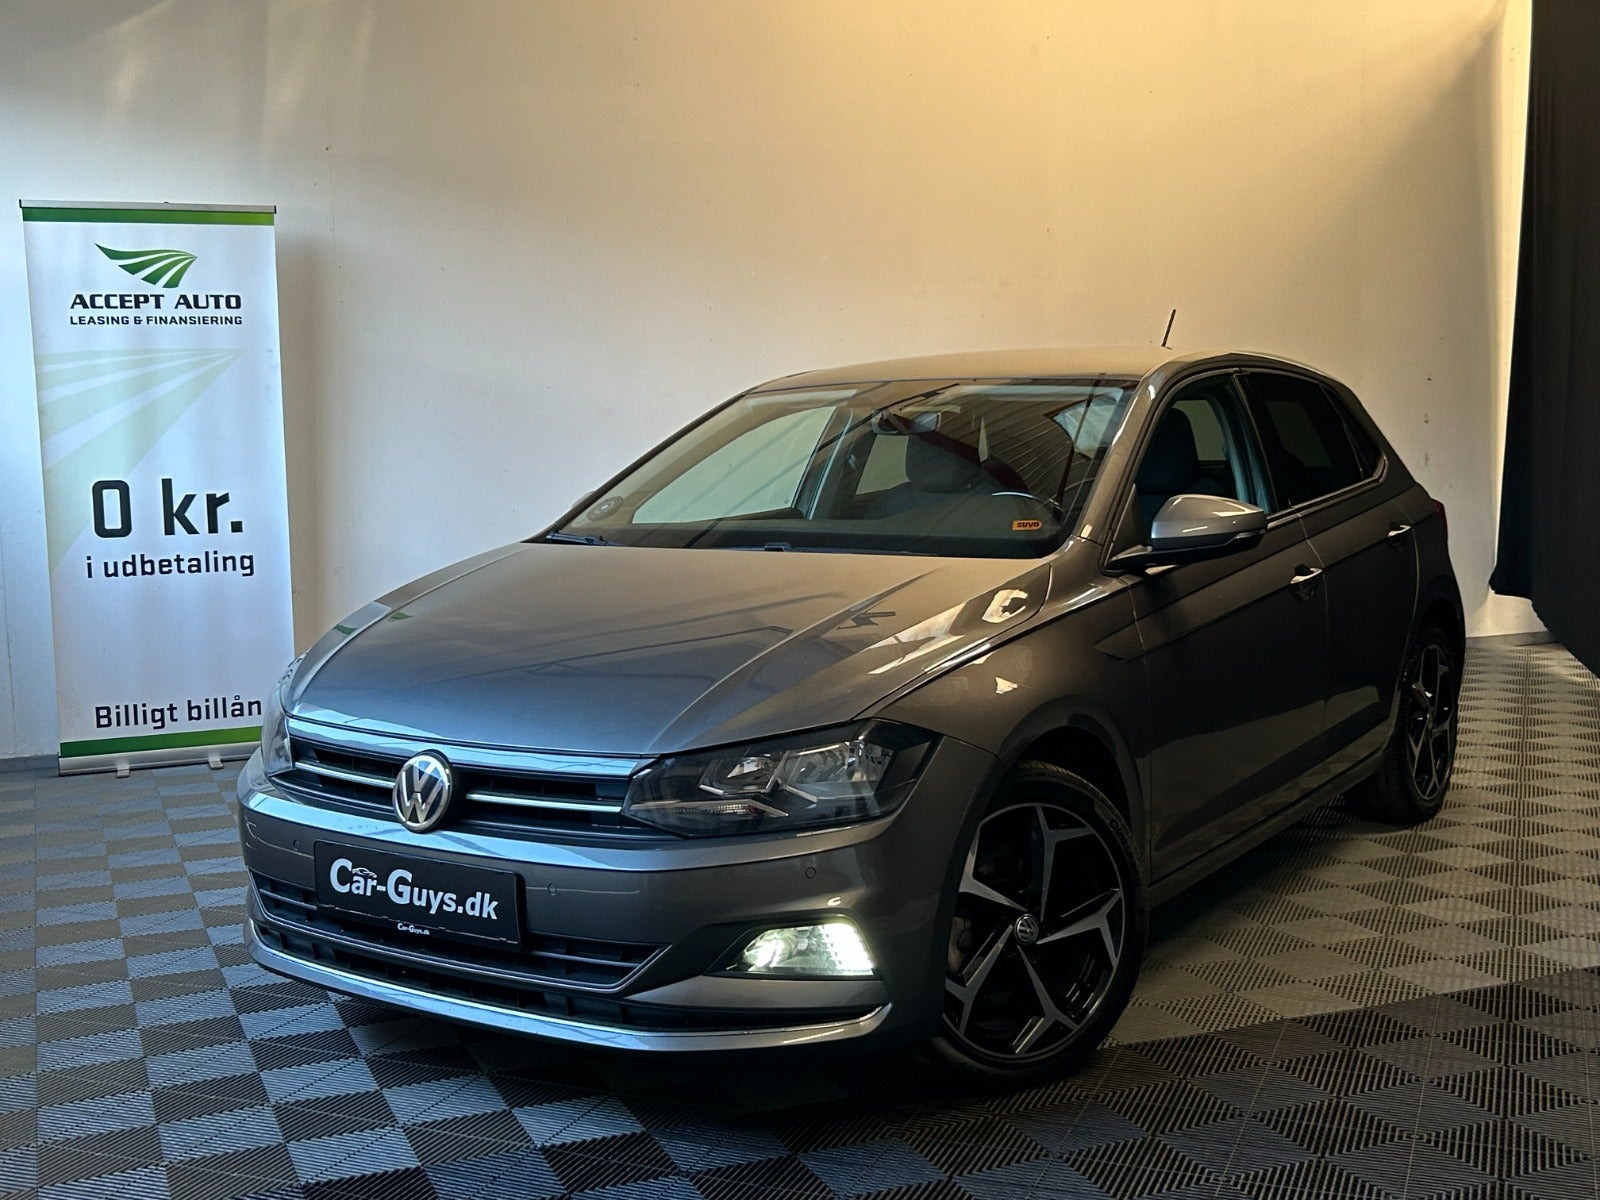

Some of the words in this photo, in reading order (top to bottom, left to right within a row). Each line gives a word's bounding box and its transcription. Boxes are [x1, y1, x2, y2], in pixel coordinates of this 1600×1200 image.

[70, 294, 165, 309] ACCEPT
[174, 295, 242, 309] AUTO
[70, 316, 130, 325] LEASING
[133, 316, 143, 325] &
[146, 316, 243, 325] FINANSIERING
[92, 480, 132, 538] 0
[161, 478, 243, 535] kr.
[86, 555, 93, 578] i
[103, 550, 255, 577] udbetaling
[95, 703, 178, 729] Billigt
[187, 695, 262, 721] billån
[330, 858, 499, 920] Car-Guys.dk
